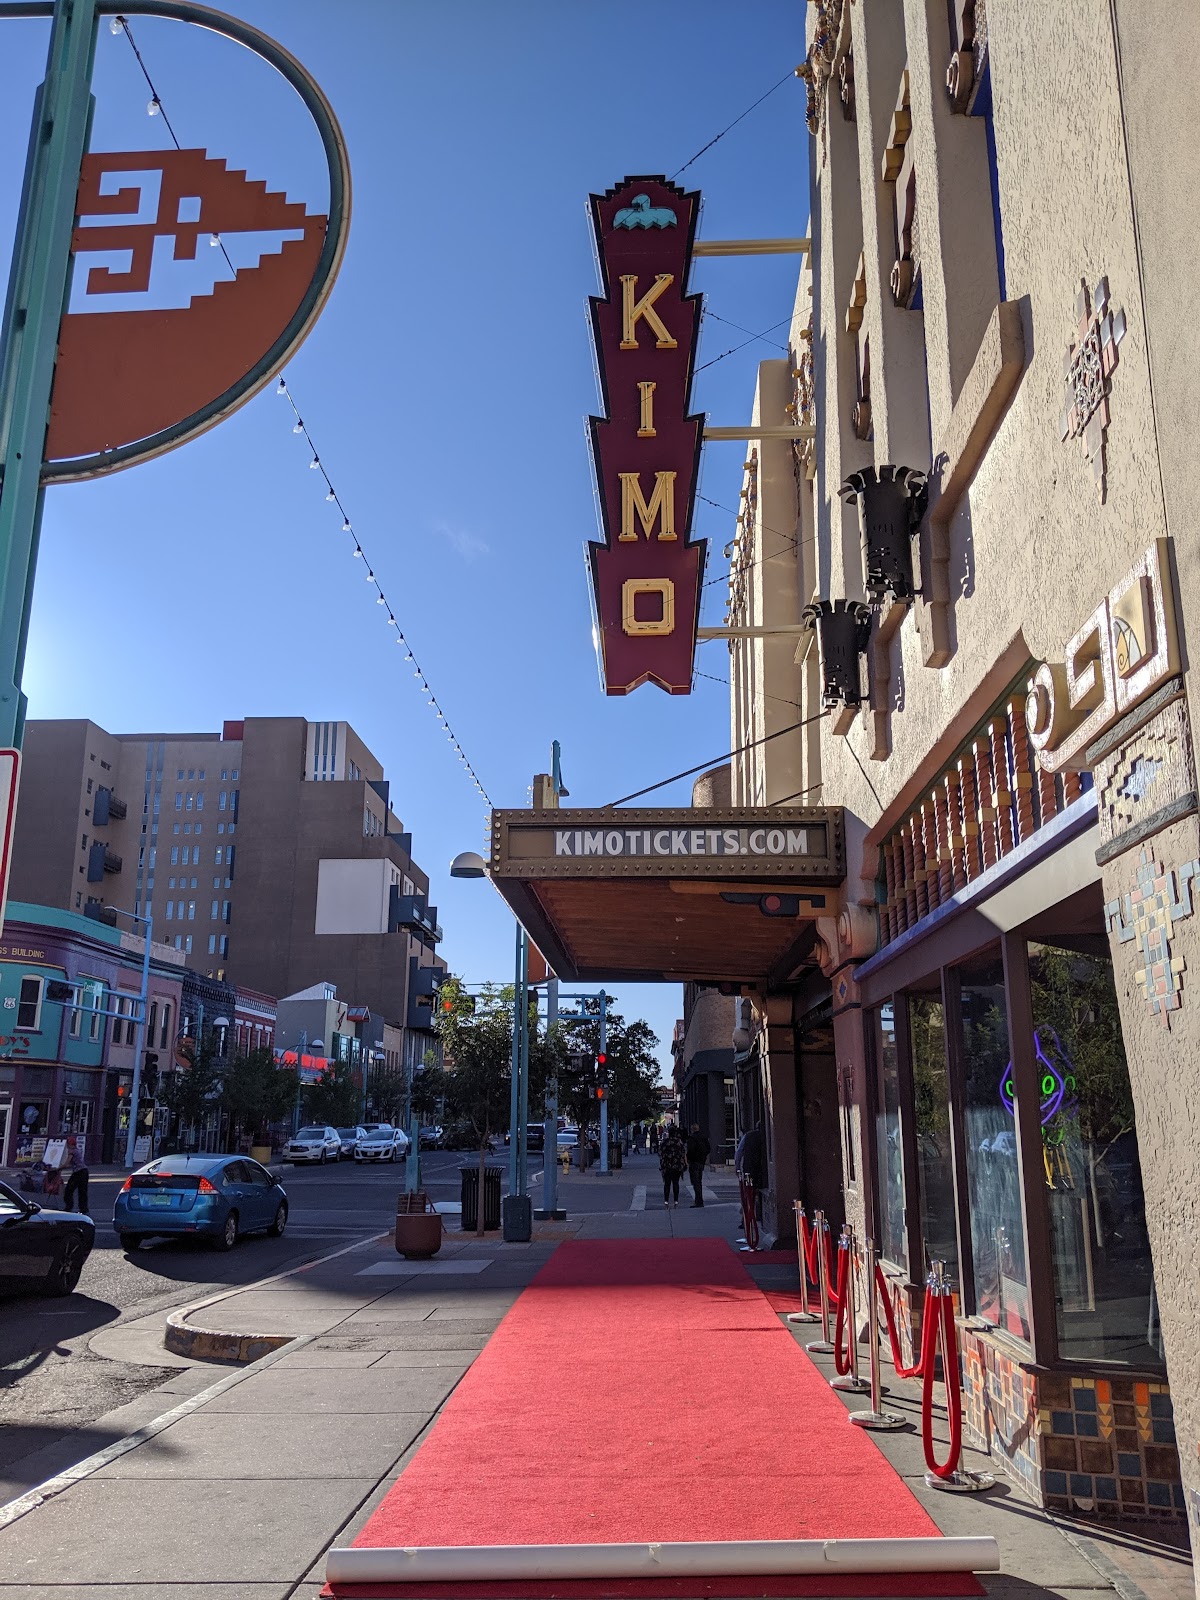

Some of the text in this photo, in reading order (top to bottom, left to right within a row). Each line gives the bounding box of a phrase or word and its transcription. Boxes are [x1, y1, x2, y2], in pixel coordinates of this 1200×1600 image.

[619, 273, 678, 637] KIMO
[555, 828, 808, 856] KIMOTICKETS.COM
[11, 947, 45, 959] BUILDING
